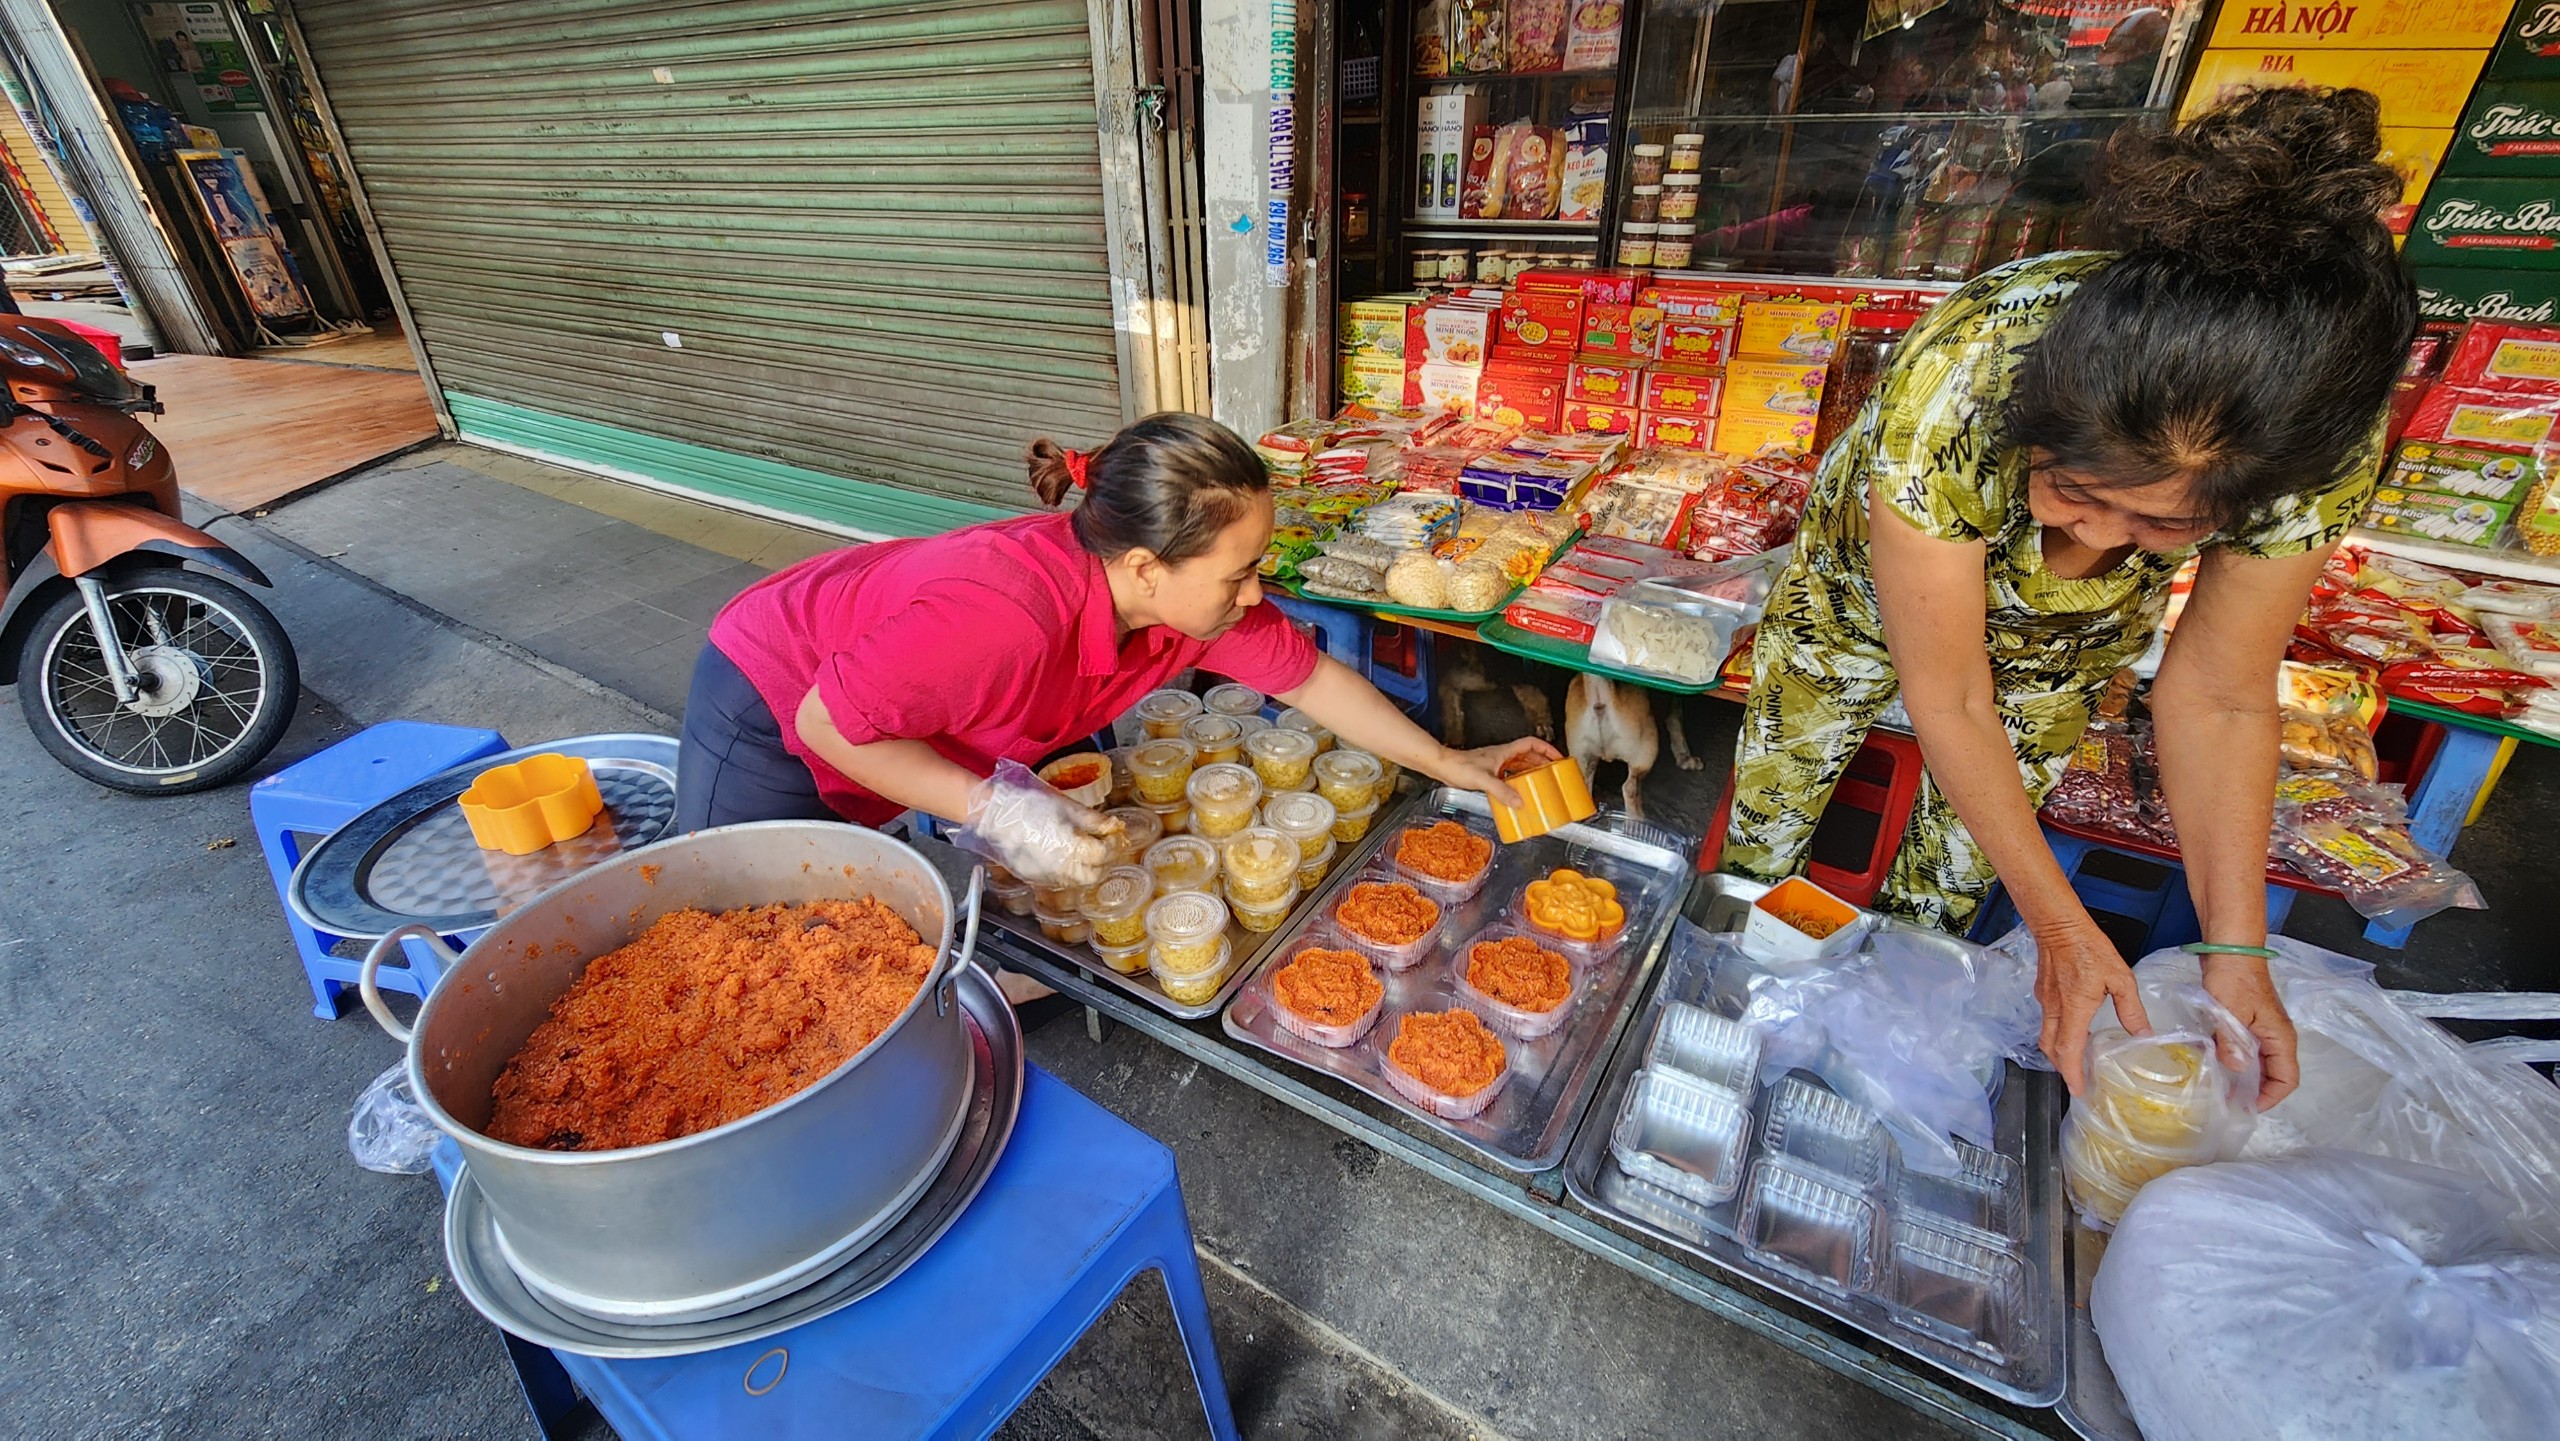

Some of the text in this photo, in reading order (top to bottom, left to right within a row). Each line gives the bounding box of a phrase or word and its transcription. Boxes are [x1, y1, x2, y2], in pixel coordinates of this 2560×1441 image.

[2241, 0, 2359, 41] HÀ NỘI
[1271, 1, 1296, 90] 0923.390.777
[2258, 55, 2295, 72] BIA
[2470, 105, 2553, 139] Trúc
[2426, 201, 2502, 231] Trúc
[2460, 237, 2541, 246] PARAMOUNT BEER
[1435, 327, 1454, 335] MINH
[1973, 312, 2044, 336] SKILLS
[1986, 333, 2008, 395] LEADERSHIP
[2397, 461, 2426, 473] Bánh
[2371, 504, 2400, 516] Bánh
[1785, 575, 1825, 645] MANA
[1827, 587, 1850, 623] PRICE
[1764, 683, 1785, 756] TRAINING
[1736, 799, 1770, 826] PRICE
